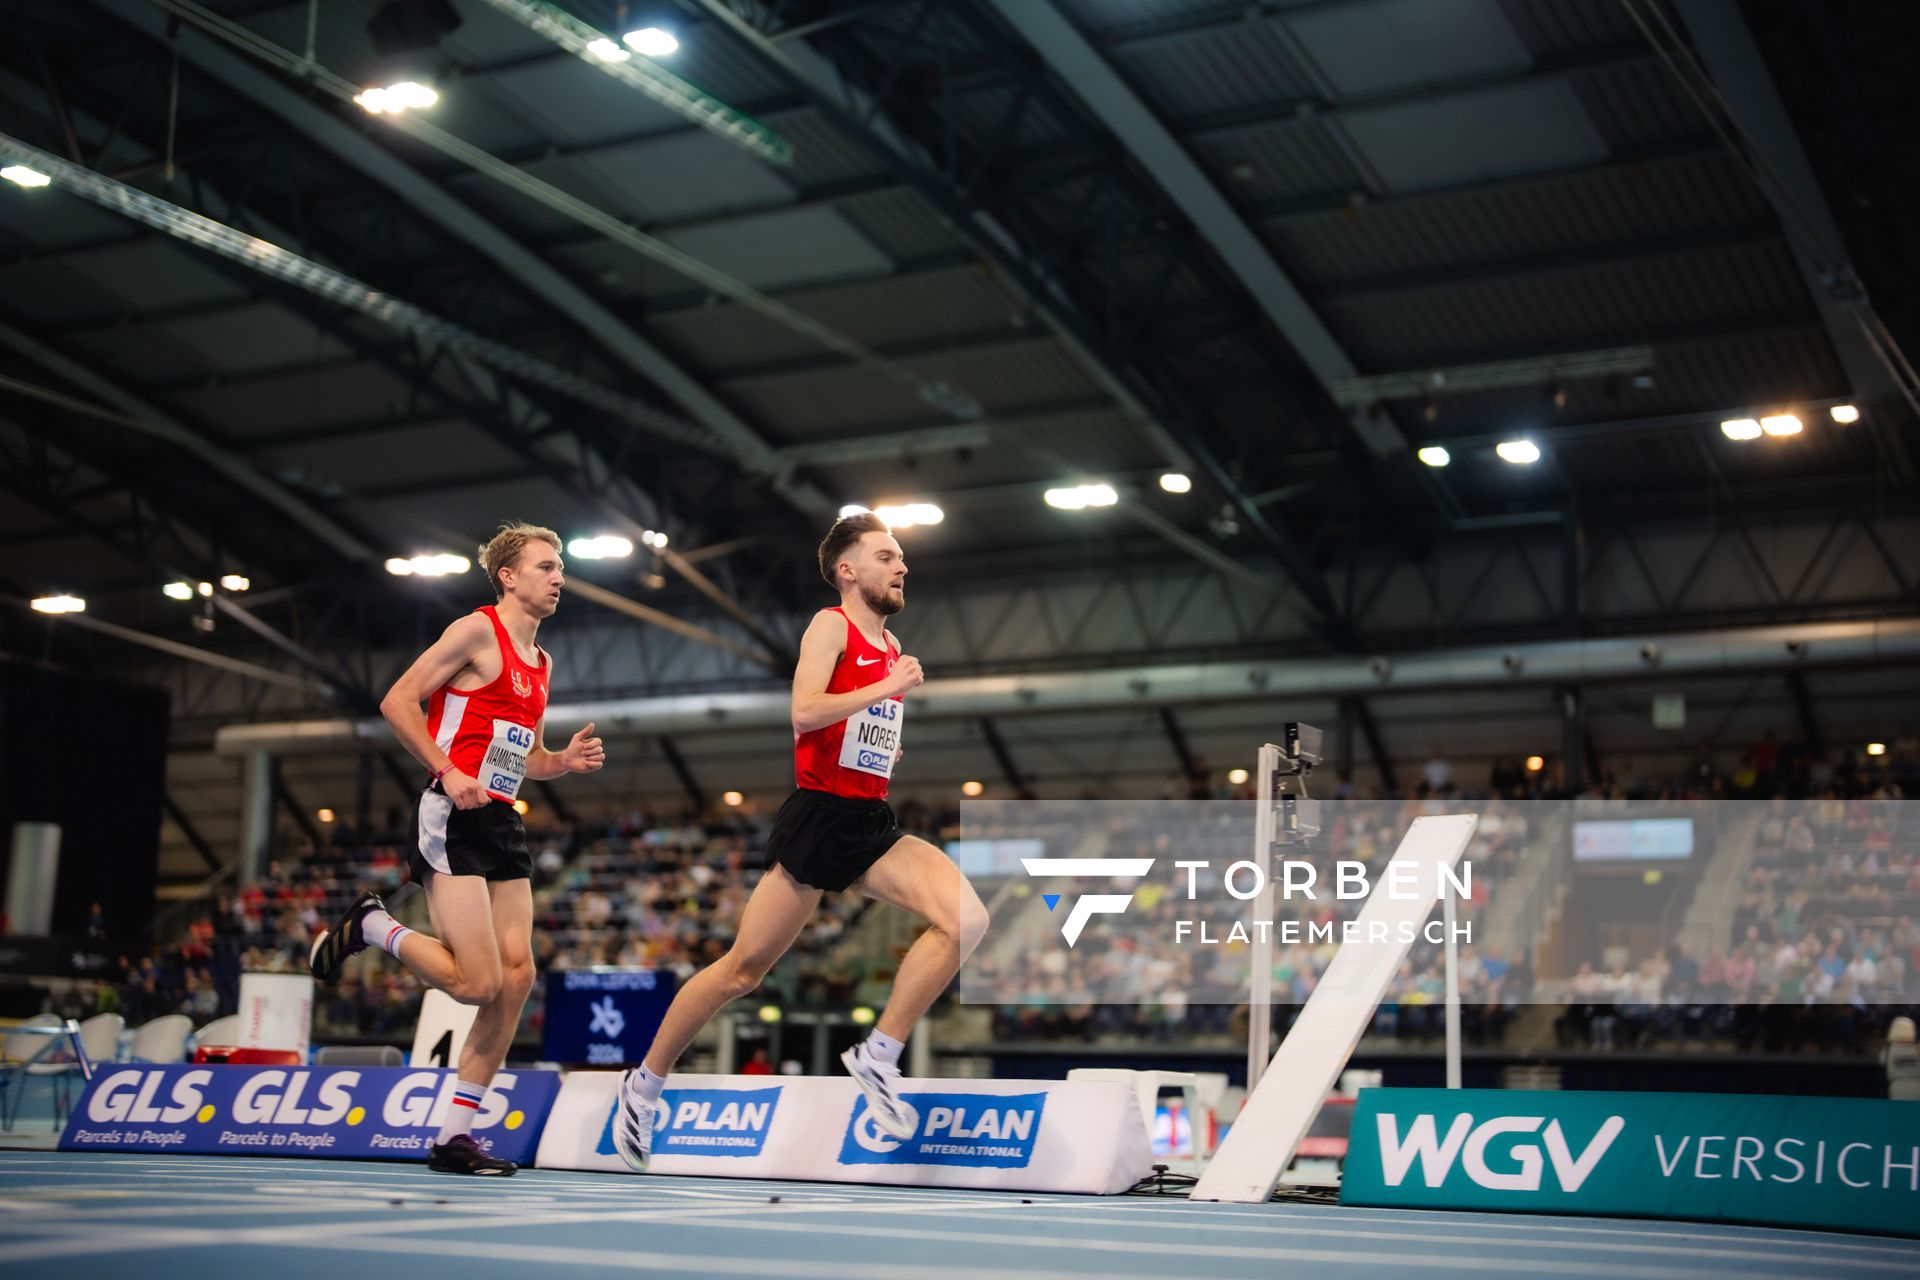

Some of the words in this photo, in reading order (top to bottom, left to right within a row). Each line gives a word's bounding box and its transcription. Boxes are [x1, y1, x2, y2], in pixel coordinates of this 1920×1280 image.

[868, 702, 897, 721] GLS
[507, 726, 531, 749] GLS
[857, 722, 897, 751] NORES
[672, 1101, 770, 1131] PLAN
[923, 1107, 1035, 1140] PLAN
[74, 1130, 122, 1143] Parcels
[123, 1131, 138, 1144] to
[139, 1130, 186, 1147] People
[219, 1131, 268, 1145] Parcels
[270, 1133, 287, 1146] to
[287, 1132, 336, 1150] People
[370, 1134, 421, 1149] Parcels
[667, 1135, 757, 1147] INTERNATIONAL
[920, 1143, 1023, 1157] INTERNATIONAL
[1376, 1112, 1625, 1193] WGV
[1654, 1134, 1920, 1191] VERSICH
